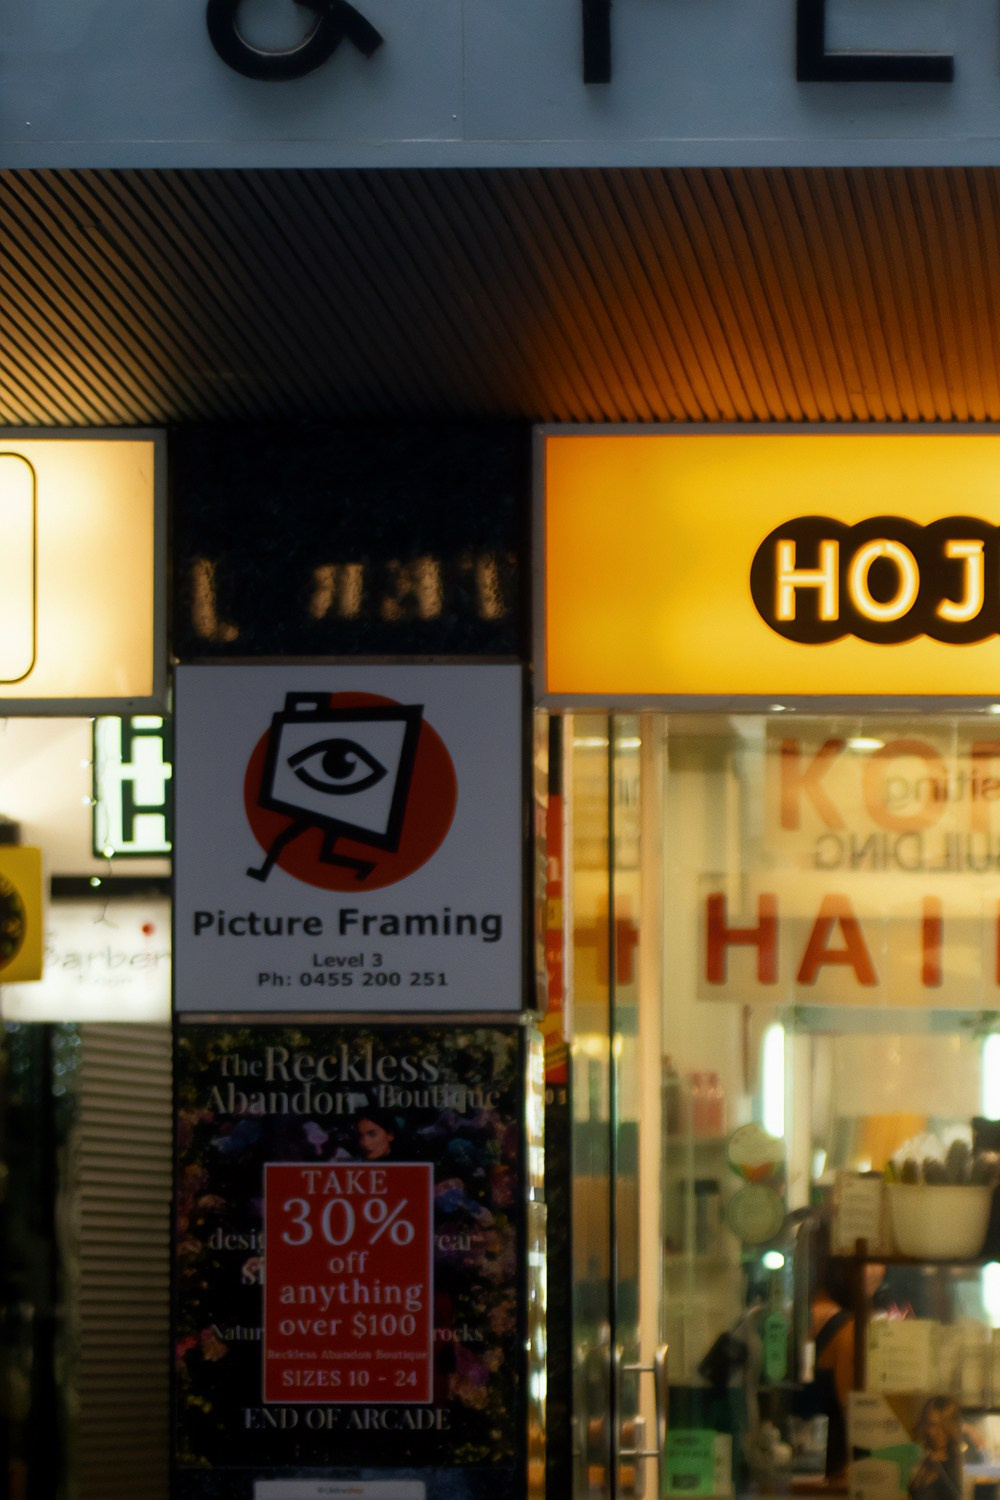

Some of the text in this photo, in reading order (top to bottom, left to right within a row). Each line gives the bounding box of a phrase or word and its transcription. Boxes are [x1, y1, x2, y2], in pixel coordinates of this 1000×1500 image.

[193, 907, 503, 943] Picture Framing
[312, 953, 383, 968] Level 3
[258, 972, 448, 987] Ph: 0455 200 251
[220, 1040, 440, 1084] The Reckless
[207, 1082, 500, 1116] Abandon Boutique
[301, 1170, 389, 1195] TAKE
[282, 1197, 415, 1247] 30%
[327, 1250, 369, 1275] off
[278, 1278, 424, 1312] anything
[278, 1313, 417, 1338] over $100
[282, 1369, 342, 1387] SIZES
[349, 1369, 370, 1387] 10
[394, 1369, 418, 1387] 24
[243, 1408, 452, 1430] END OF ARCADE
